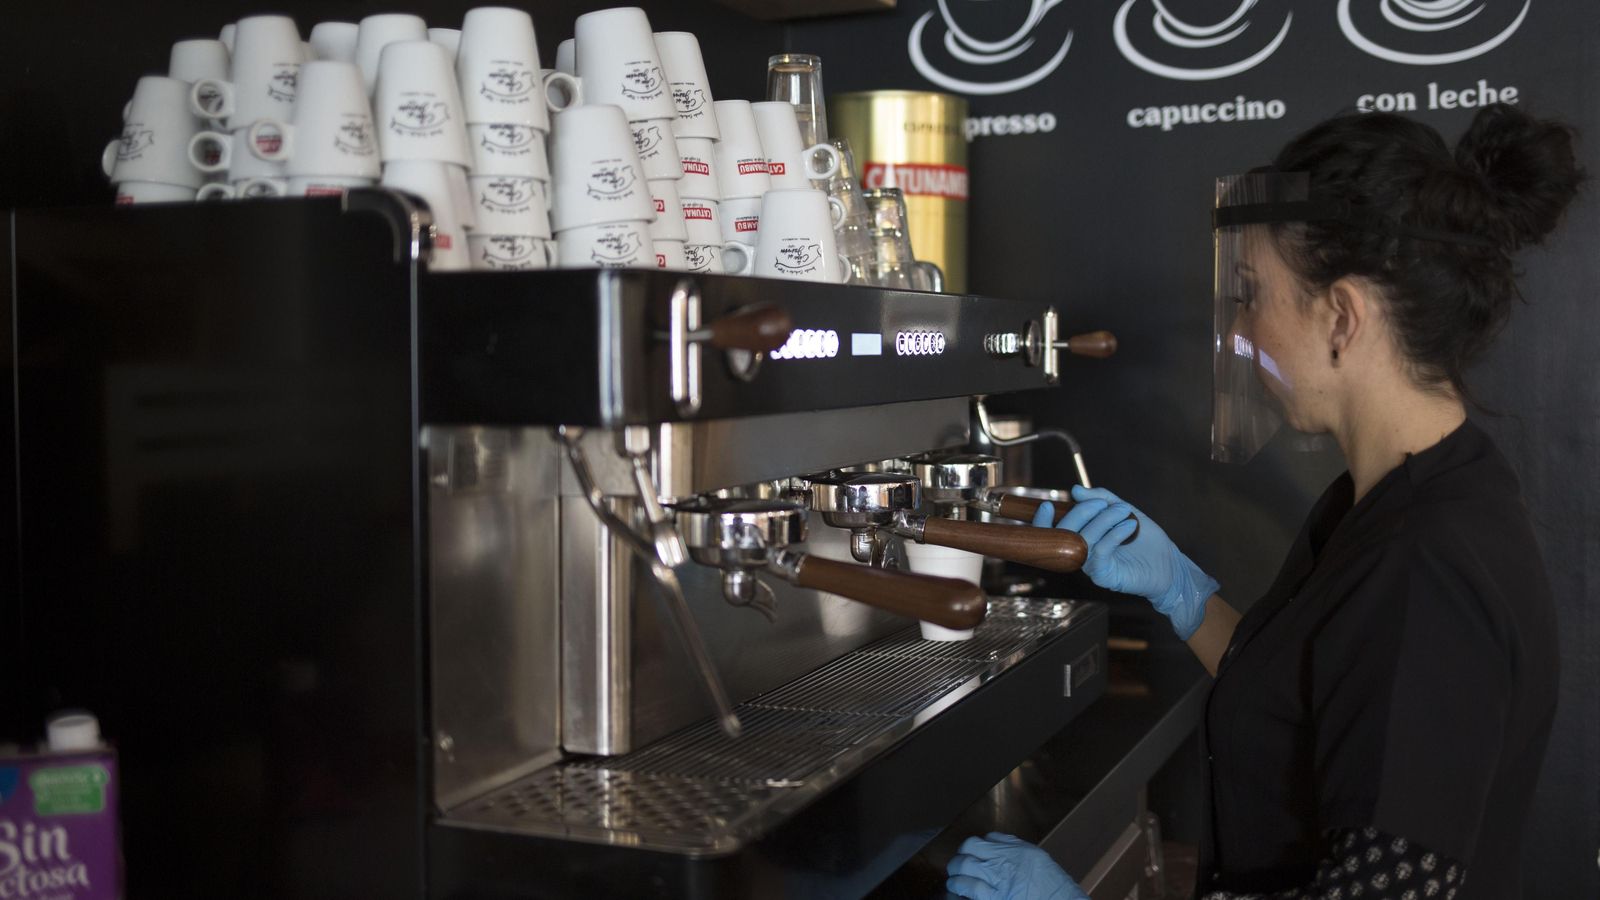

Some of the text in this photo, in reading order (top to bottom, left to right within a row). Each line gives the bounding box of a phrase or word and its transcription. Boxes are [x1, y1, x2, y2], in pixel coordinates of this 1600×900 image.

[1127, 95, 1286, 131] capuccino
[1357, 79, 1519, 113] con leche
[964, 112, 1056, 142] presso
[0, 820, 71, 875] Sin
